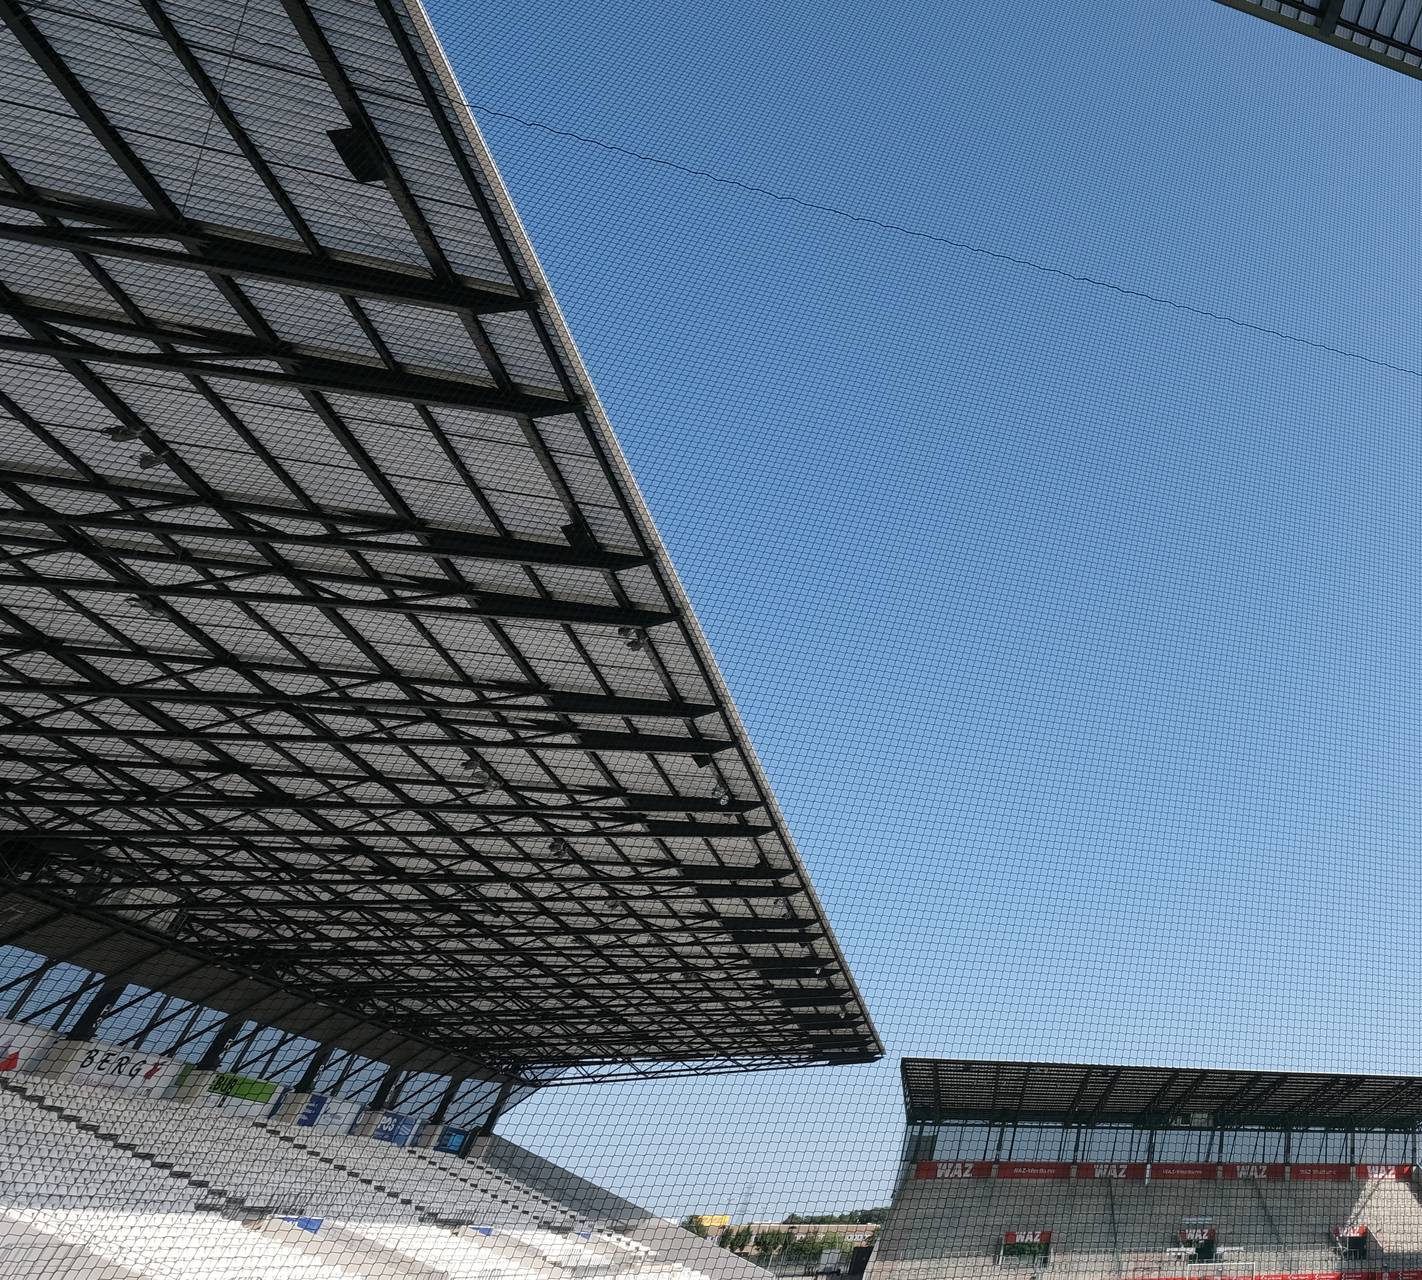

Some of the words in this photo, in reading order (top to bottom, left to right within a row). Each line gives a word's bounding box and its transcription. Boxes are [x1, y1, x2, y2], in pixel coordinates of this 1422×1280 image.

[80, 1048, 147, 1077] BERG
[936, 1163, 975, 1178] WAZ
[1093, 1164, 1128, 1178] WAZ
[1236, 1165, 1268, 1179] WAZ
[1366, 1165, 1396, 1179] WAZ
[1015, 1231, 1041, 1243] WAZ
[1185, 1229, 1209, 1240] WAZ
